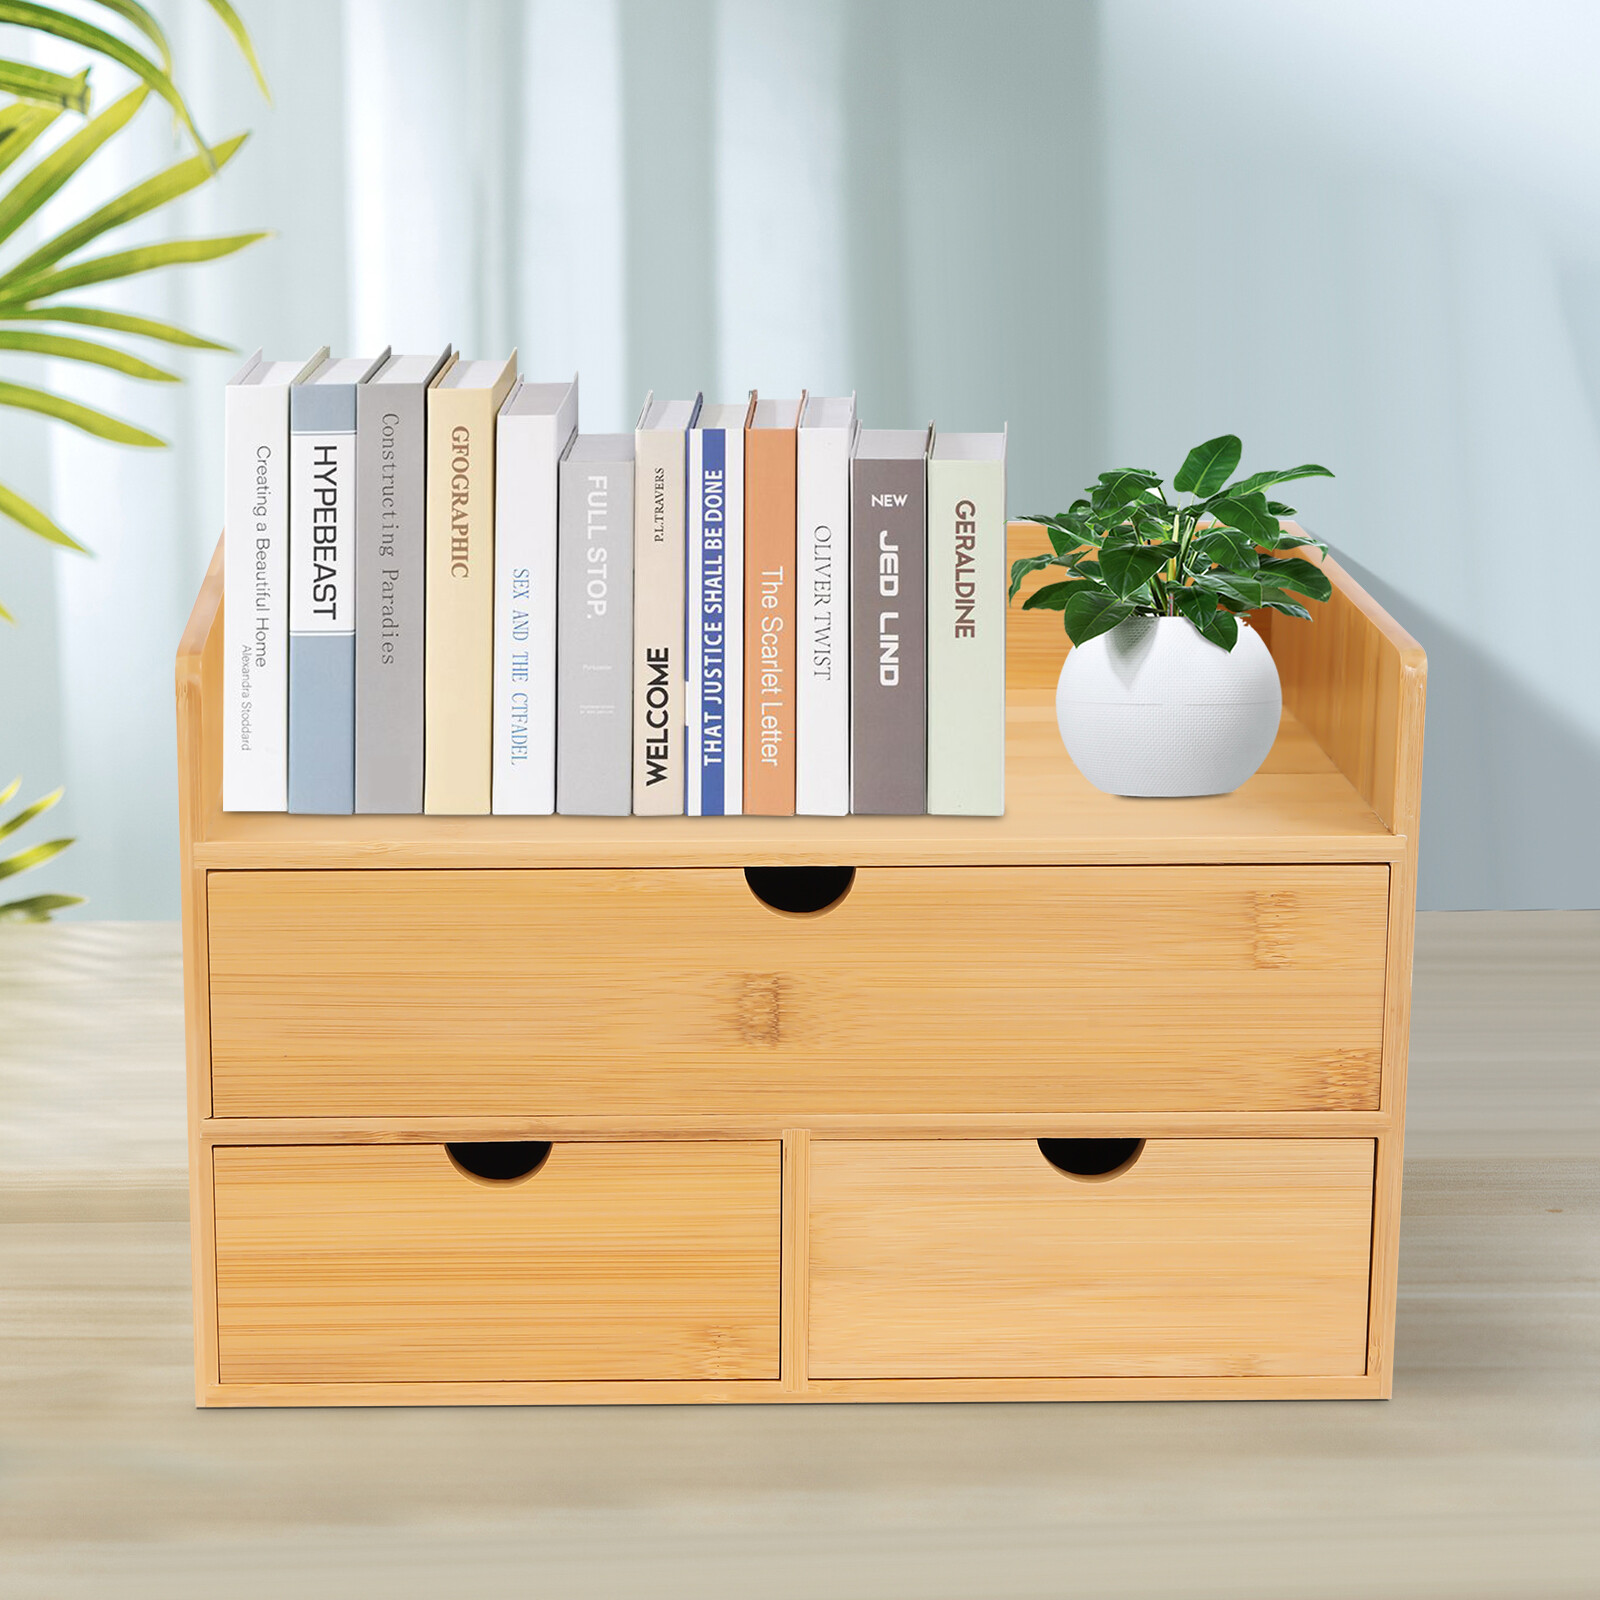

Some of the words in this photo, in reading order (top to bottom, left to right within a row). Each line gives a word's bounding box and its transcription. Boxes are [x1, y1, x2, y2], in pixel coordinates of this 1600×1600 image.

[253, 446, 271, 516] Creating
[379, 413, 399, 557] Constructing
[587, 475, 608, 539] FULL
[704, 470, 723, 521] DONE
[871, 494, 908, 508] NEW
[255, 522, 268, 532] a
[313, 446, 337, 620] HYPEBEAST
[704, 528, 723, 549] BE
[255, 538, 271, 612] Beautiful
[513, 569, 529, 599] SEX
[586, 547, 608, 619] STOP.
[704, 555, 723, 613] SHALL
[760, 566, 784, 608] The
[813, 525, 832, 606] OLIVER
[879, 530, 899, 597] JED
[955, 500, 976, 639] GERALDINE
[255, 618, 270, 667] Home
[381, 569, 399, 665] Paradies
[513, 610, 529, 641] AND
[813, 611, 832, 681] TWIST
[879, 611, 899, 687] LIND
[241, 645, 253, 699] Alexandra
[512, 651, 528, 682] THE
[703, 622, 722, 704] JUSTICE
[760, 615, 784, 695] Scarlet
[240, 702, 252, 751] Stoddard
[646, 647, 669, 786] WELCOME
[703, 711, 722, 766] THAT
[760, 701, 784, 766] Letter
